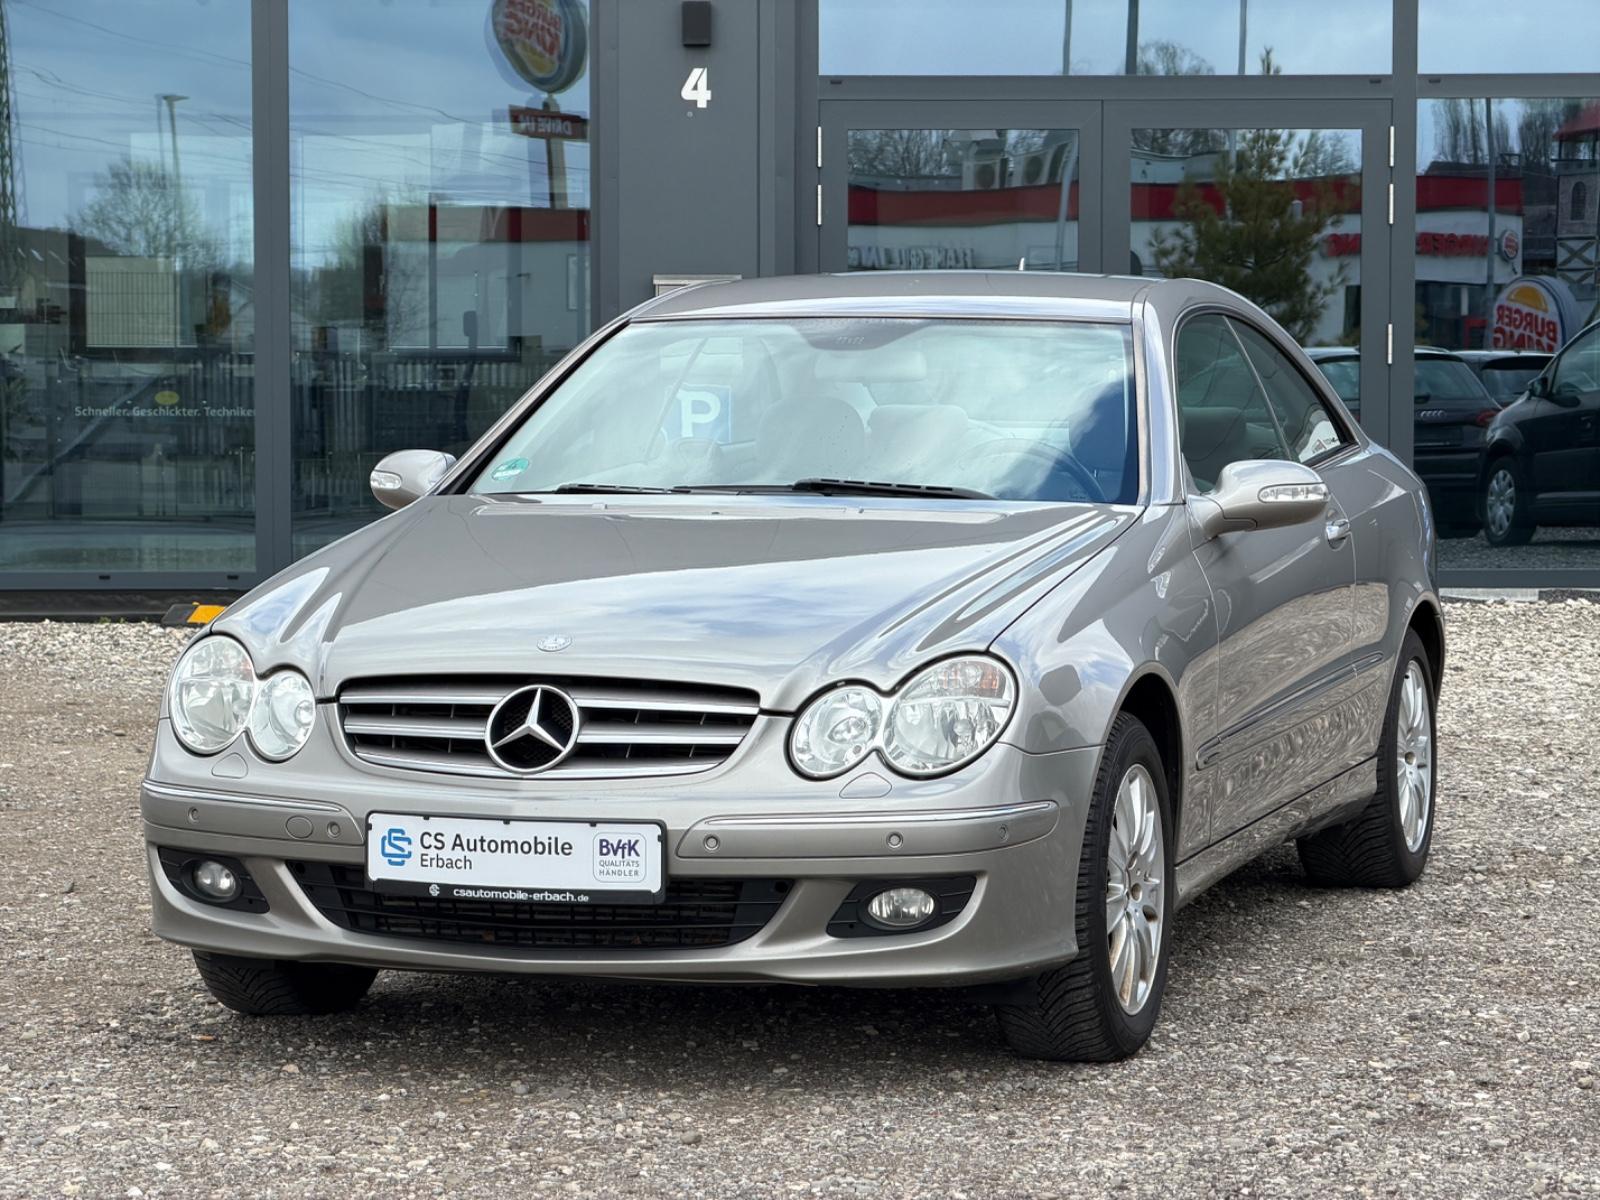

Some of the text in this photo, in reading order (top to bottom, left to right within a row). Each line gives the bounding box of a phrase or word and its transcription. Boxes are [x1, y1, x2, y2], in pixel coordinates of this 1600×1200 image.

[681, 67, 711, 108] 4
[74, 406, 130, 417] Schneller.
[132, 406, 201, 417] Geschickter.
[677, 390, 720, 438] P
[420, 832, 573, 856] CS Automobile
[420, 853, 472, 870] Erbach
[453, 888, 589, 902] csautomobile-erbach.de
